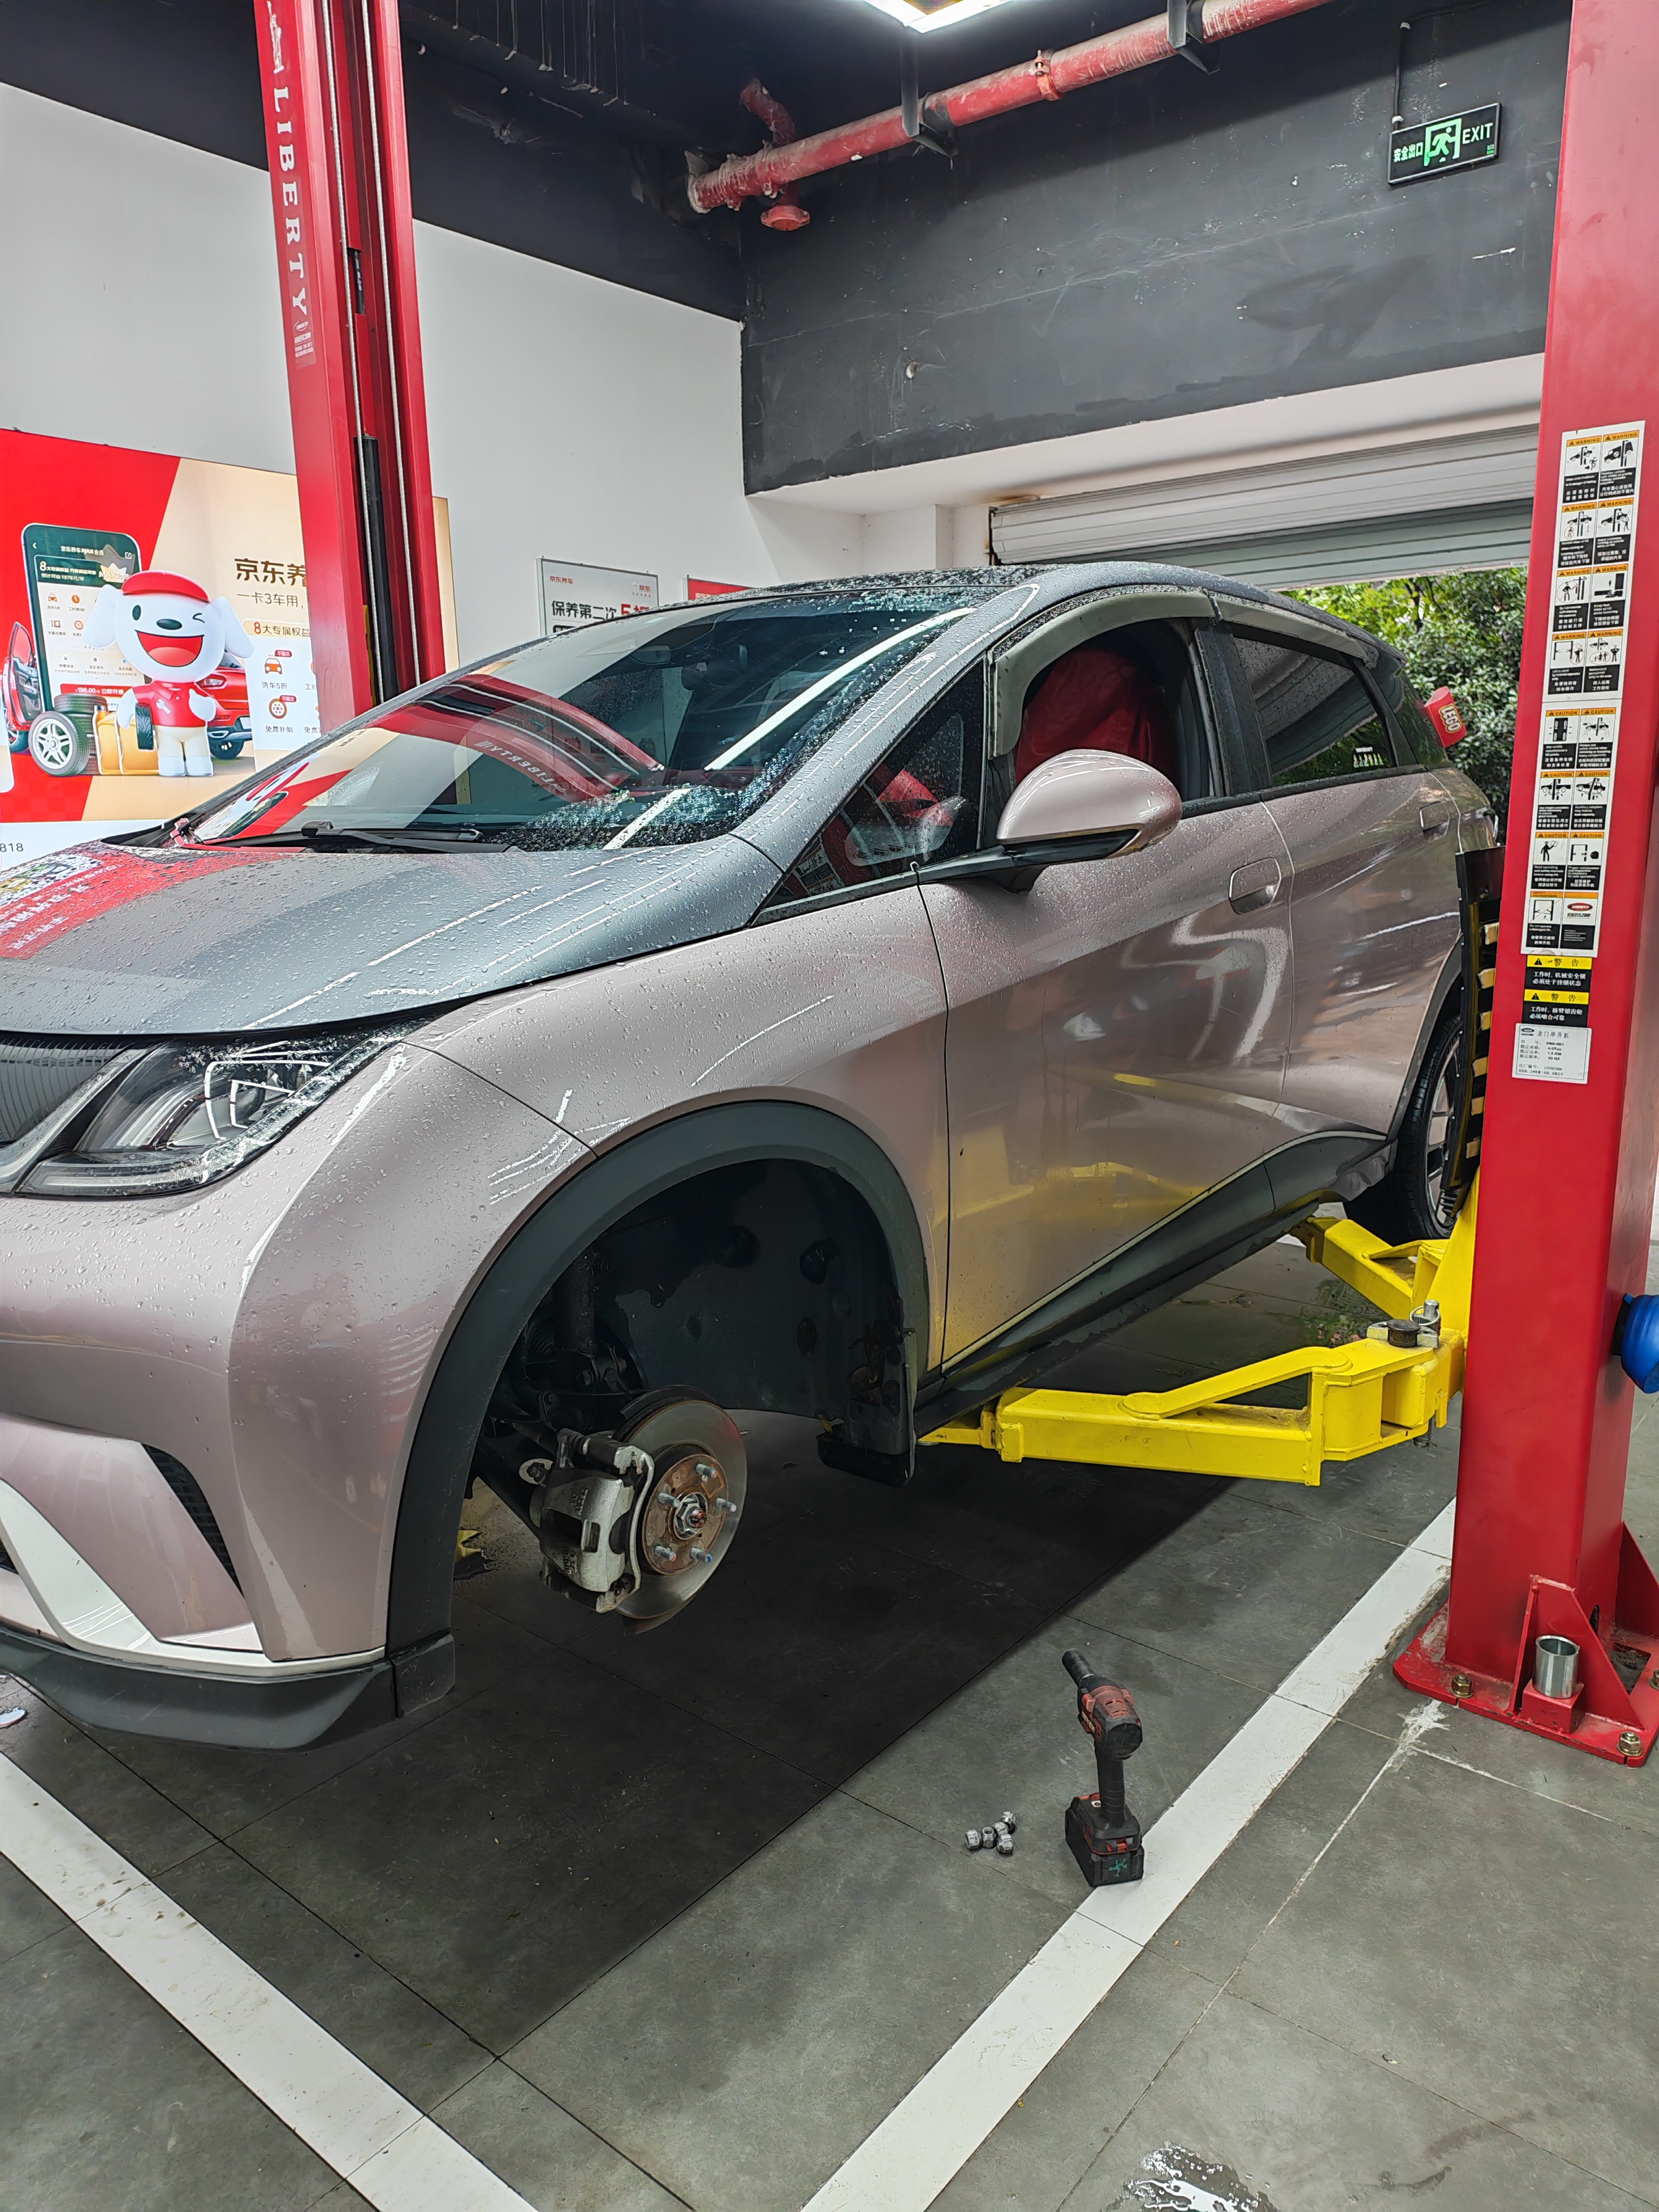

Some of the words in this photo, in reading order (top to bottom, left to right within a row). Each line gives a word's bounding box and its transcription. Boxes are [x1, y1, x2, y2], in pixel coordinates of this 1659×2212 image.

[1462, 123, 1493, 144] EXIT
[1393, 142, 1424, 163] 安全出口
[274, 86, 307, 315] LIBERTY
[551, 601, 617, 620] 保养第二次
[261, 682, 287, 690] 洗车5折
[1440, 705, 1461, 732] LEGO
